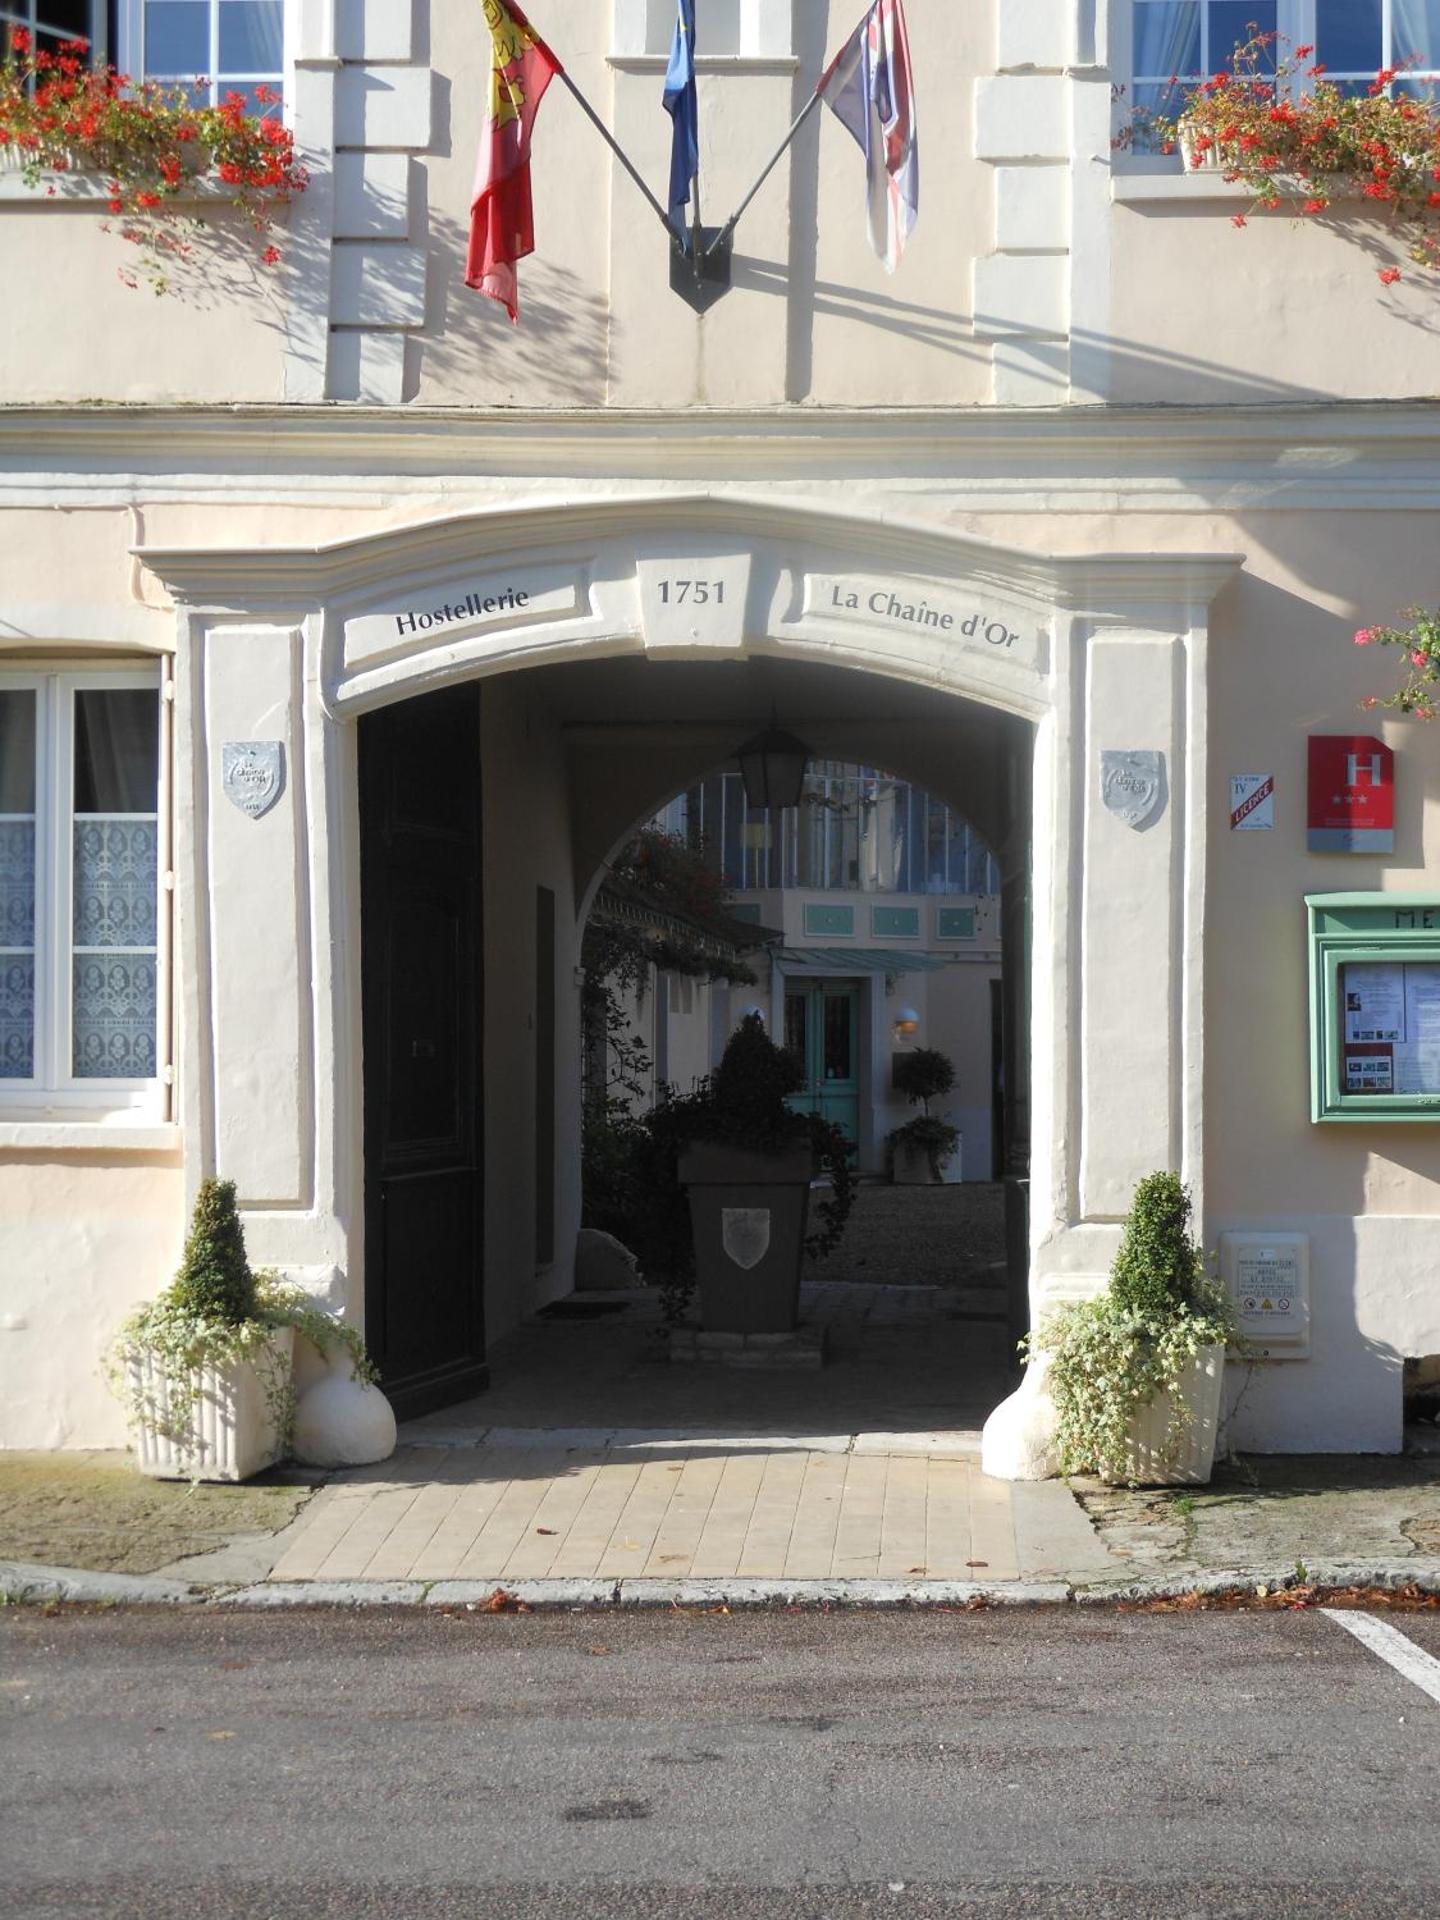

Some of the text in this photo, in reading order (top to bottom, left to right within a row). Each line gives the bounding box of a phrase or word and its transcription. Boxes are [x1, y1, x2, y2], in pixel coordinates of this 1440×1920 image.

[658, 581, 724, 604] 1751
[397, 588, 528, 635] Hostellerie
[832, 585, 1019, 648] La Chaîne d'Or
[1346, 754, 1384, 786] H
[1235, 783, 1247, 794] IV
[1236, 782, 1270, 822] LICENCE
